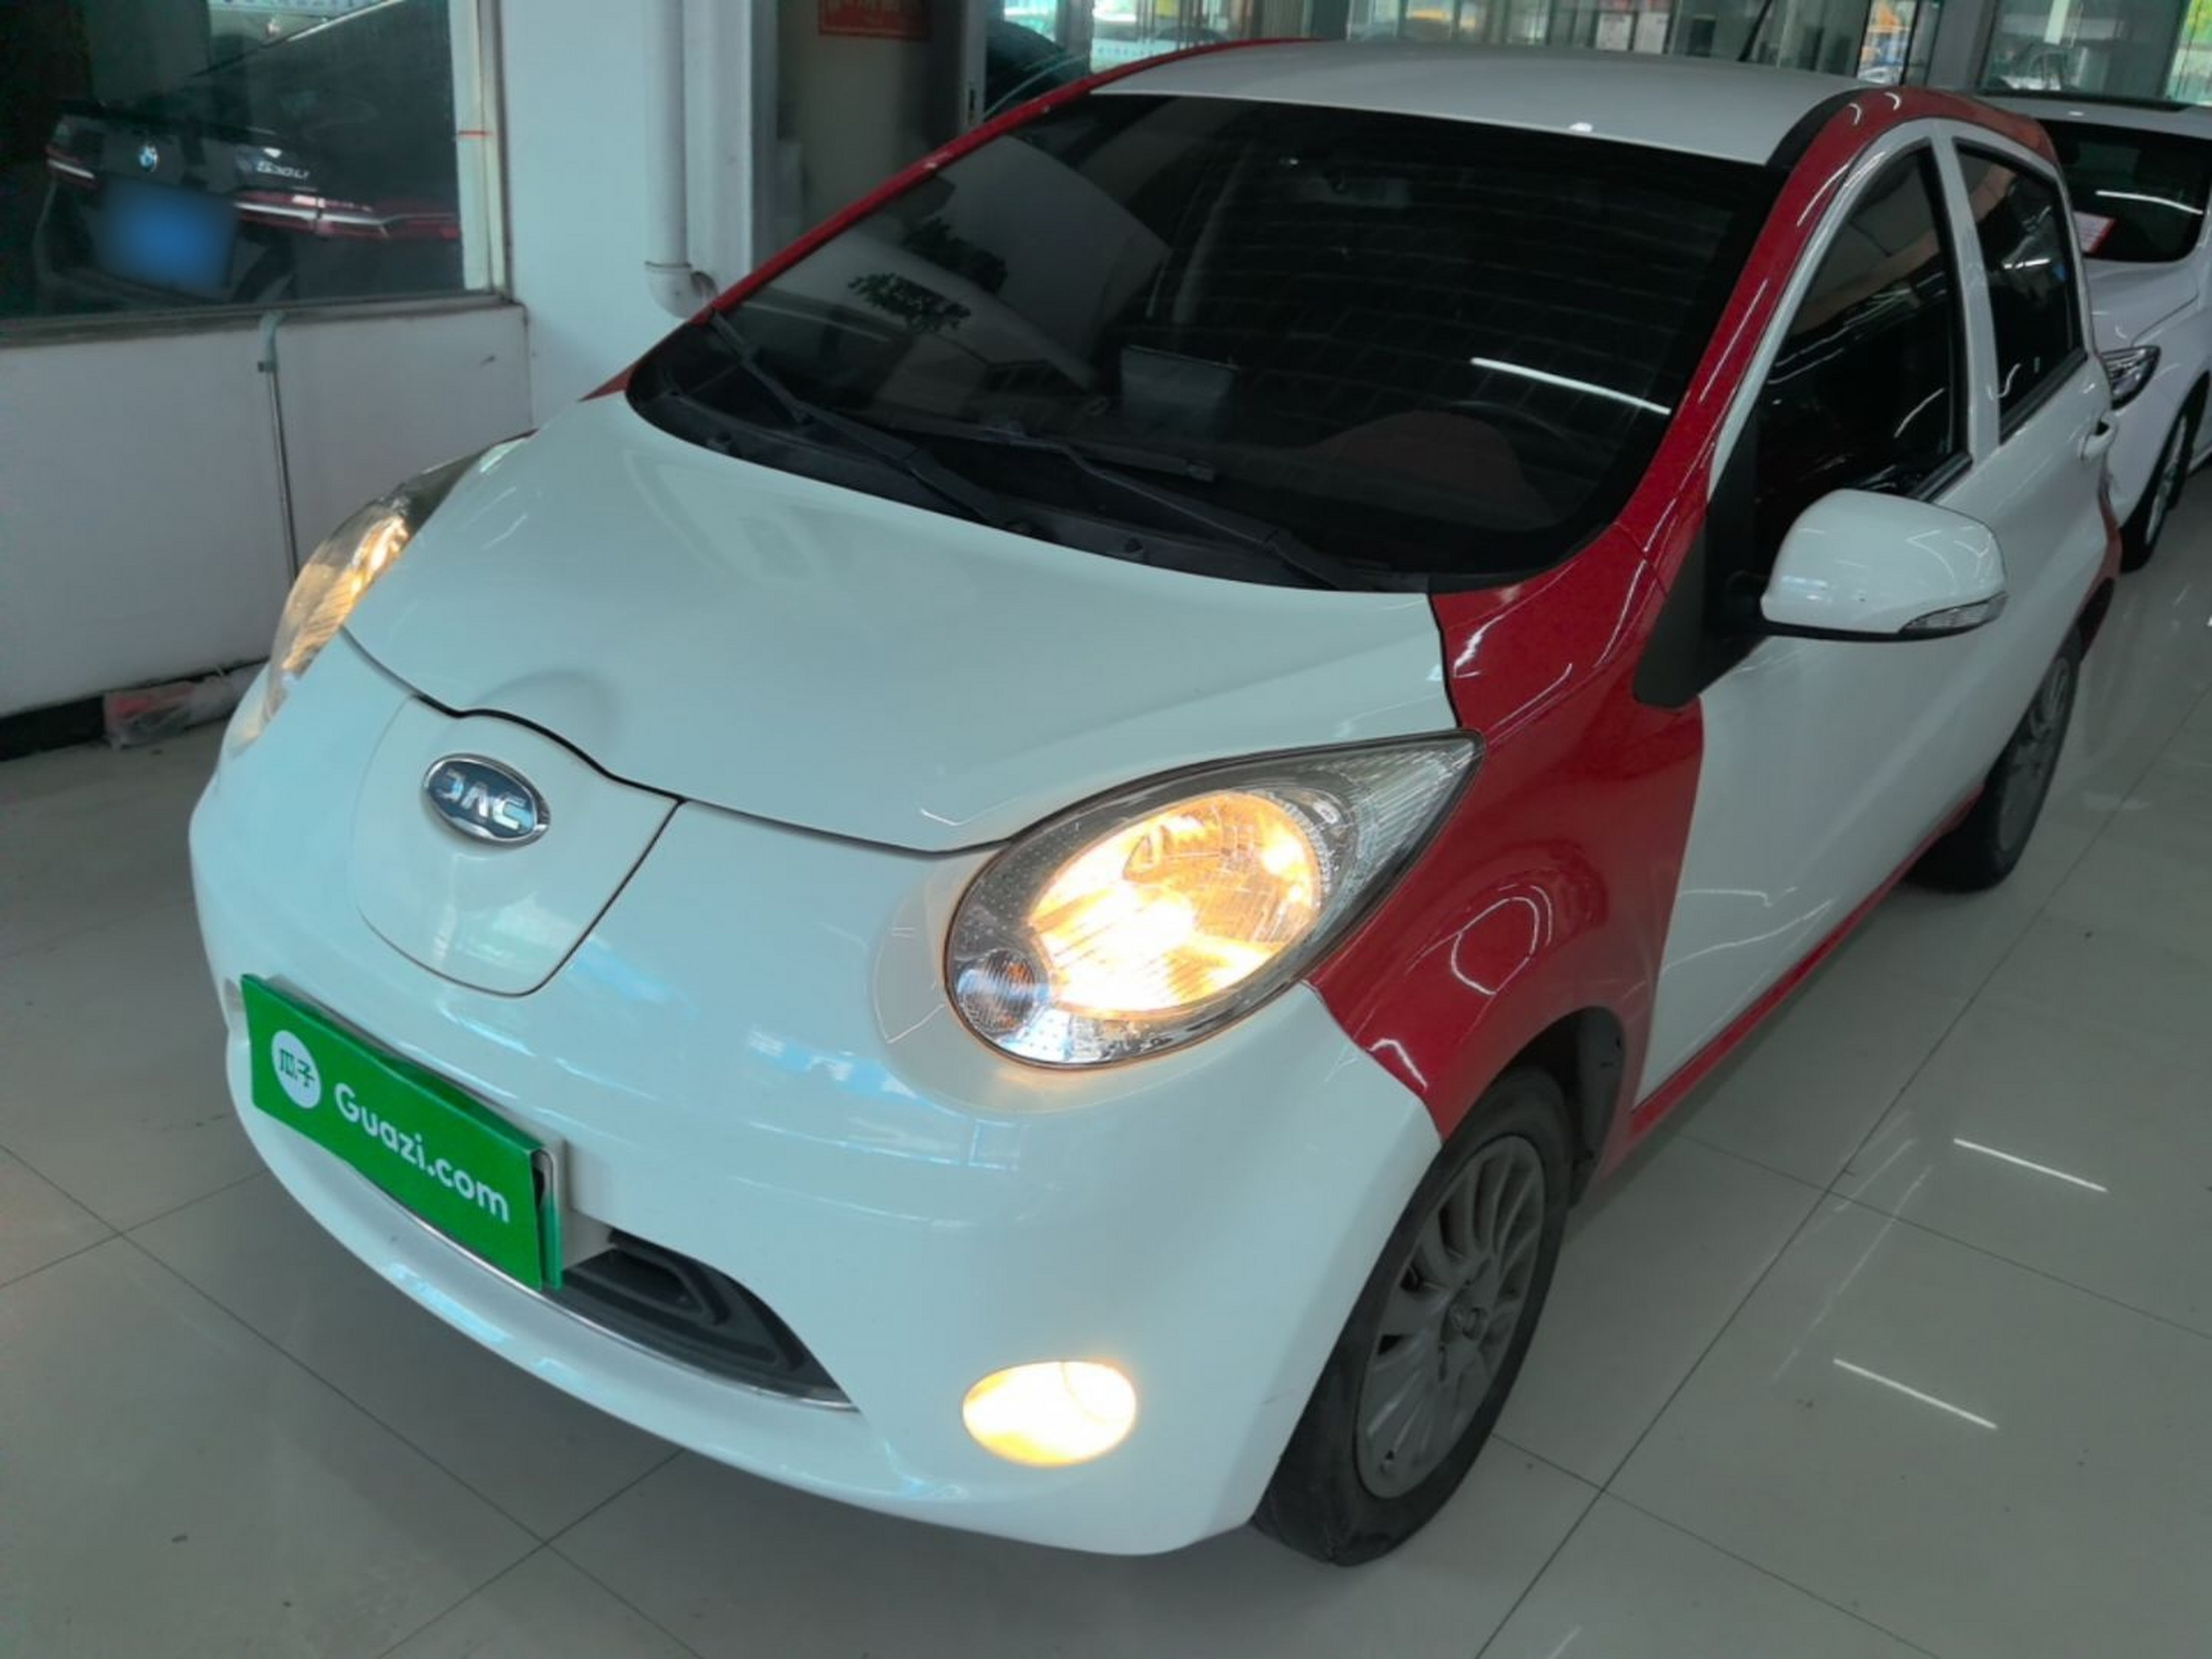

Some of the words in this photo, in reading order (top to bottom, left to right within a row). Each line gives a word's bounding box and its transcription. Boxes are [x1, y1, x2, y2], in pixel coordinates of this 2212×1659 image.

[439, 768, 527, 831] JAC
[279, 1048, 316, 1089] 瓜子
[334, 1082, 510, 1223] Guazi.com
